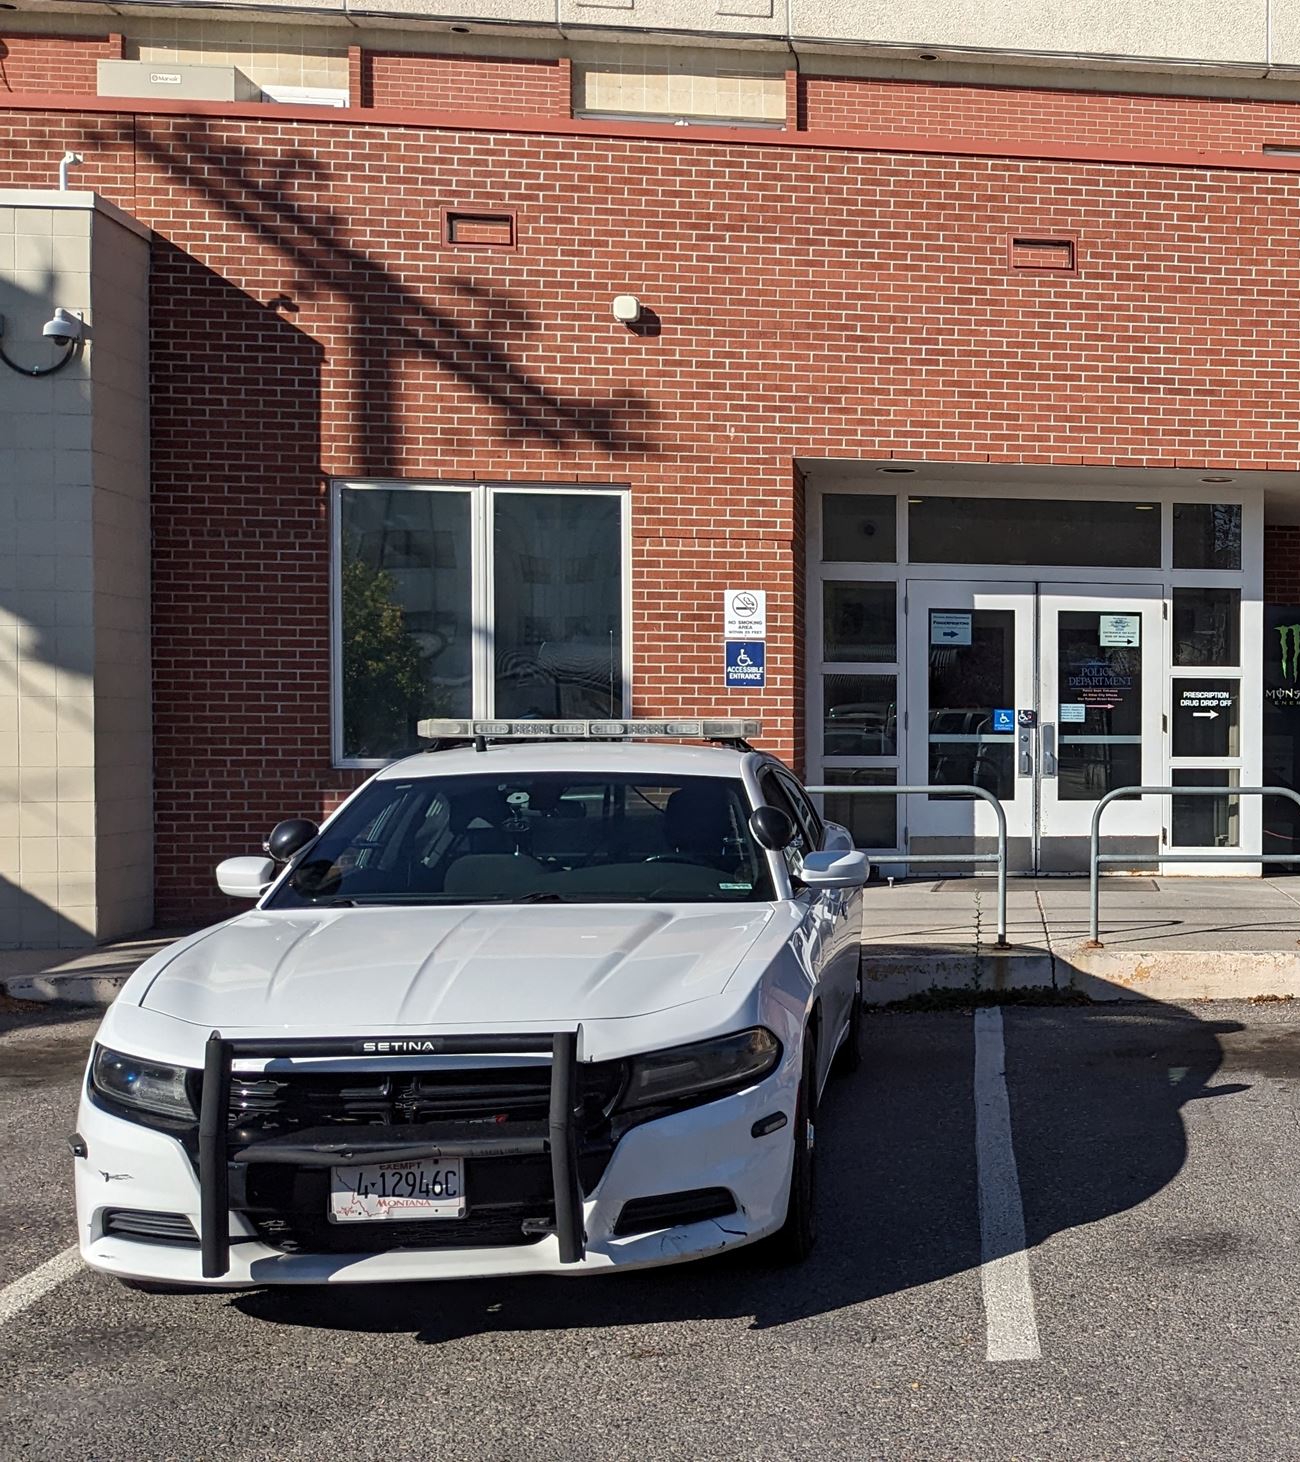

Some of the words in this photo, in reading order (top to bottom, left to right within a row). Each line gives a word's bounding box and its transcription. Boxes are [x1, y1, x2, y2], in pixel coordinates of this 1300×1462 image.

[1069, 677, 1132, 686] DEPARTMENT
[363, 1042, 434, 1051] SETINA
[379, 1162, 422, 1170] EXEMPT
[357, 1172, 369, 1199] 4
[377, 1170, 457, 1198] 12946C
[376, 1199, 431, 1207] MONTANA
